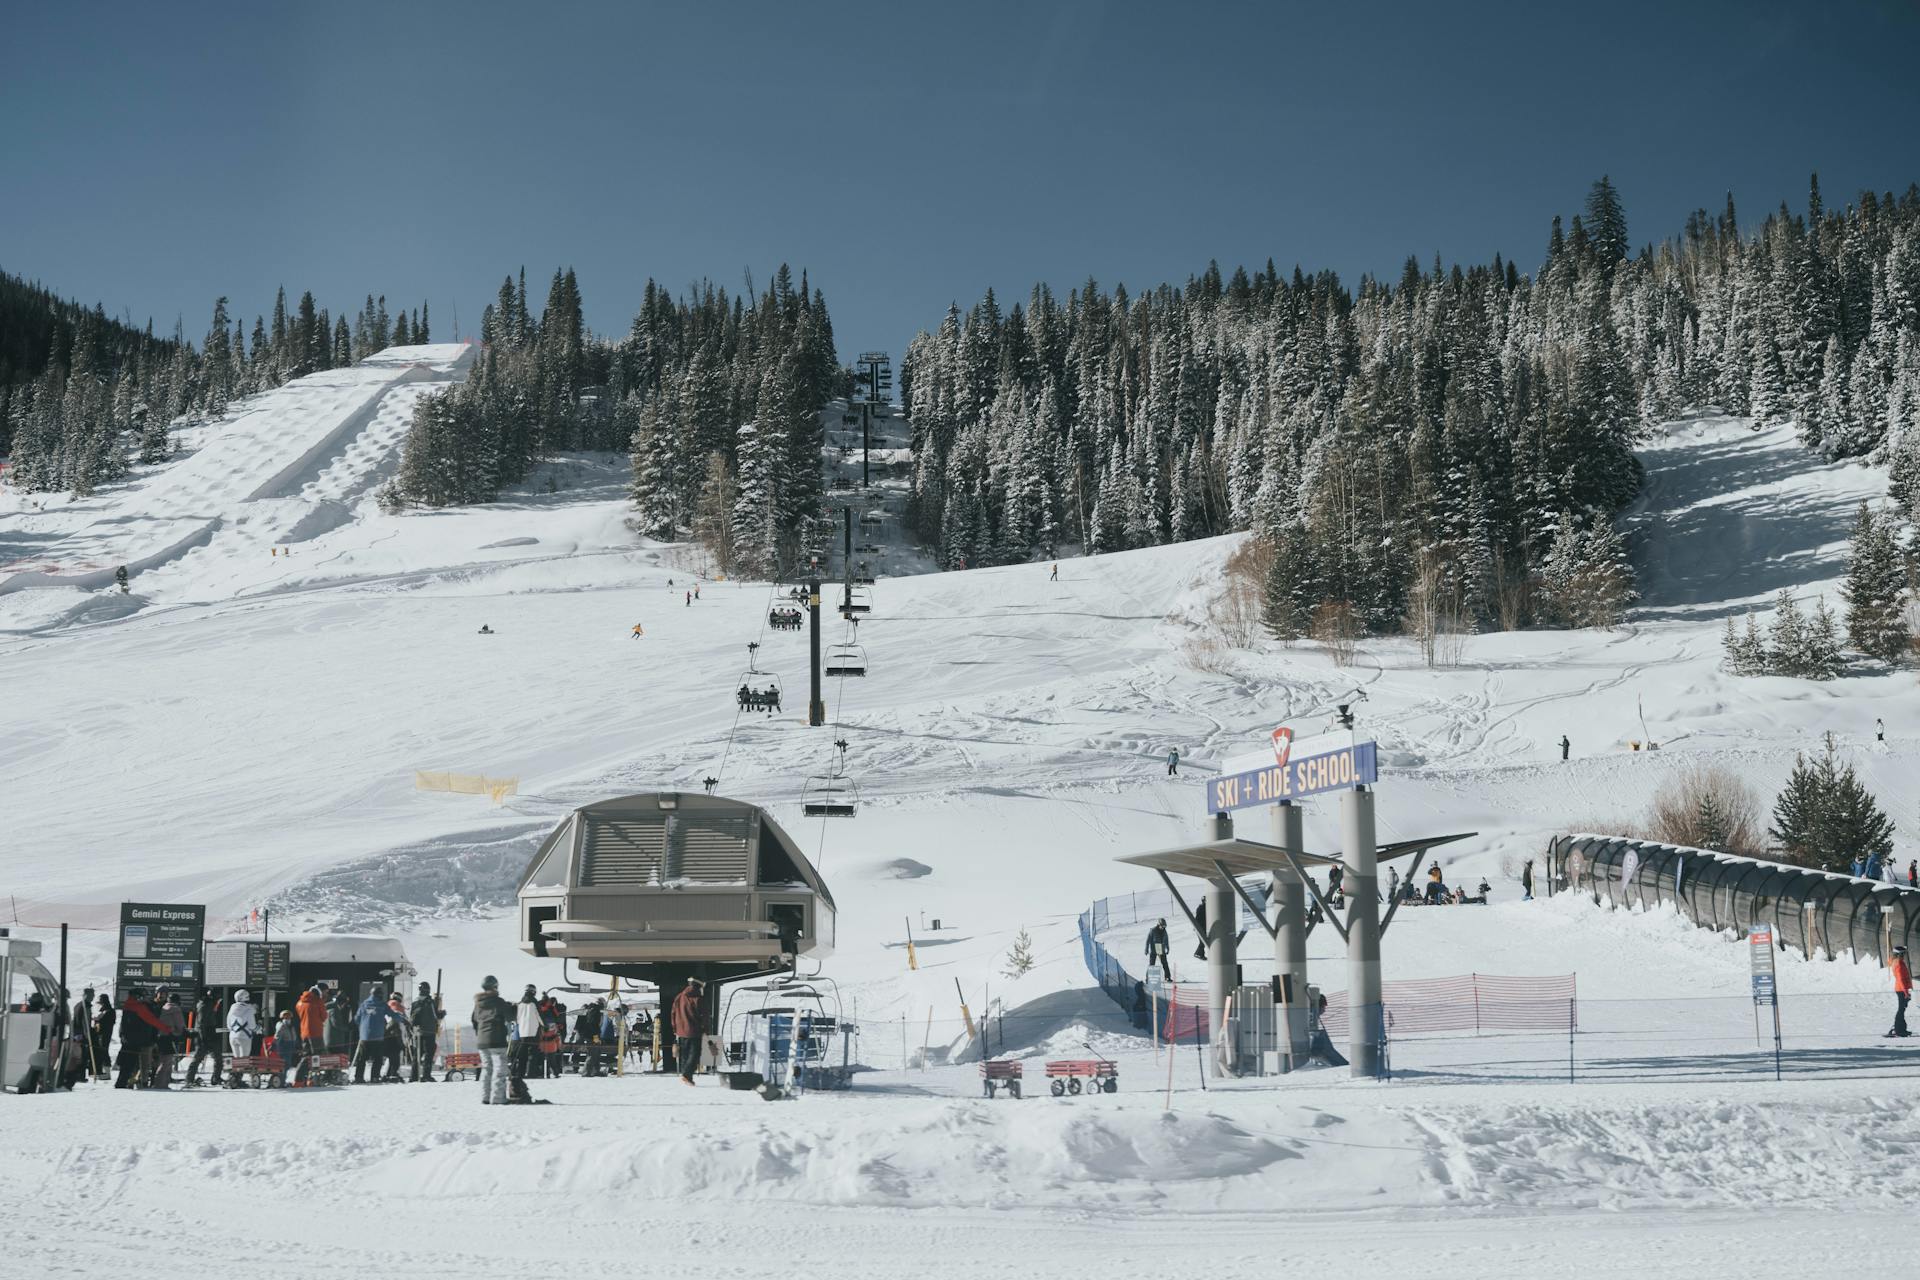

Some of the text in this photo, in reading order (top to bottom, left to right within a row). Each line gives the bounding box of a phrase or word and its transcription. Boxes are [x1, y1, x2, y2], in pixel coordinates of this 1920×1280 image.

[1217, 751, 1361, 809] SKI + RIDE SCHOOL
[131, 909, 196, 920] Gemini Express
